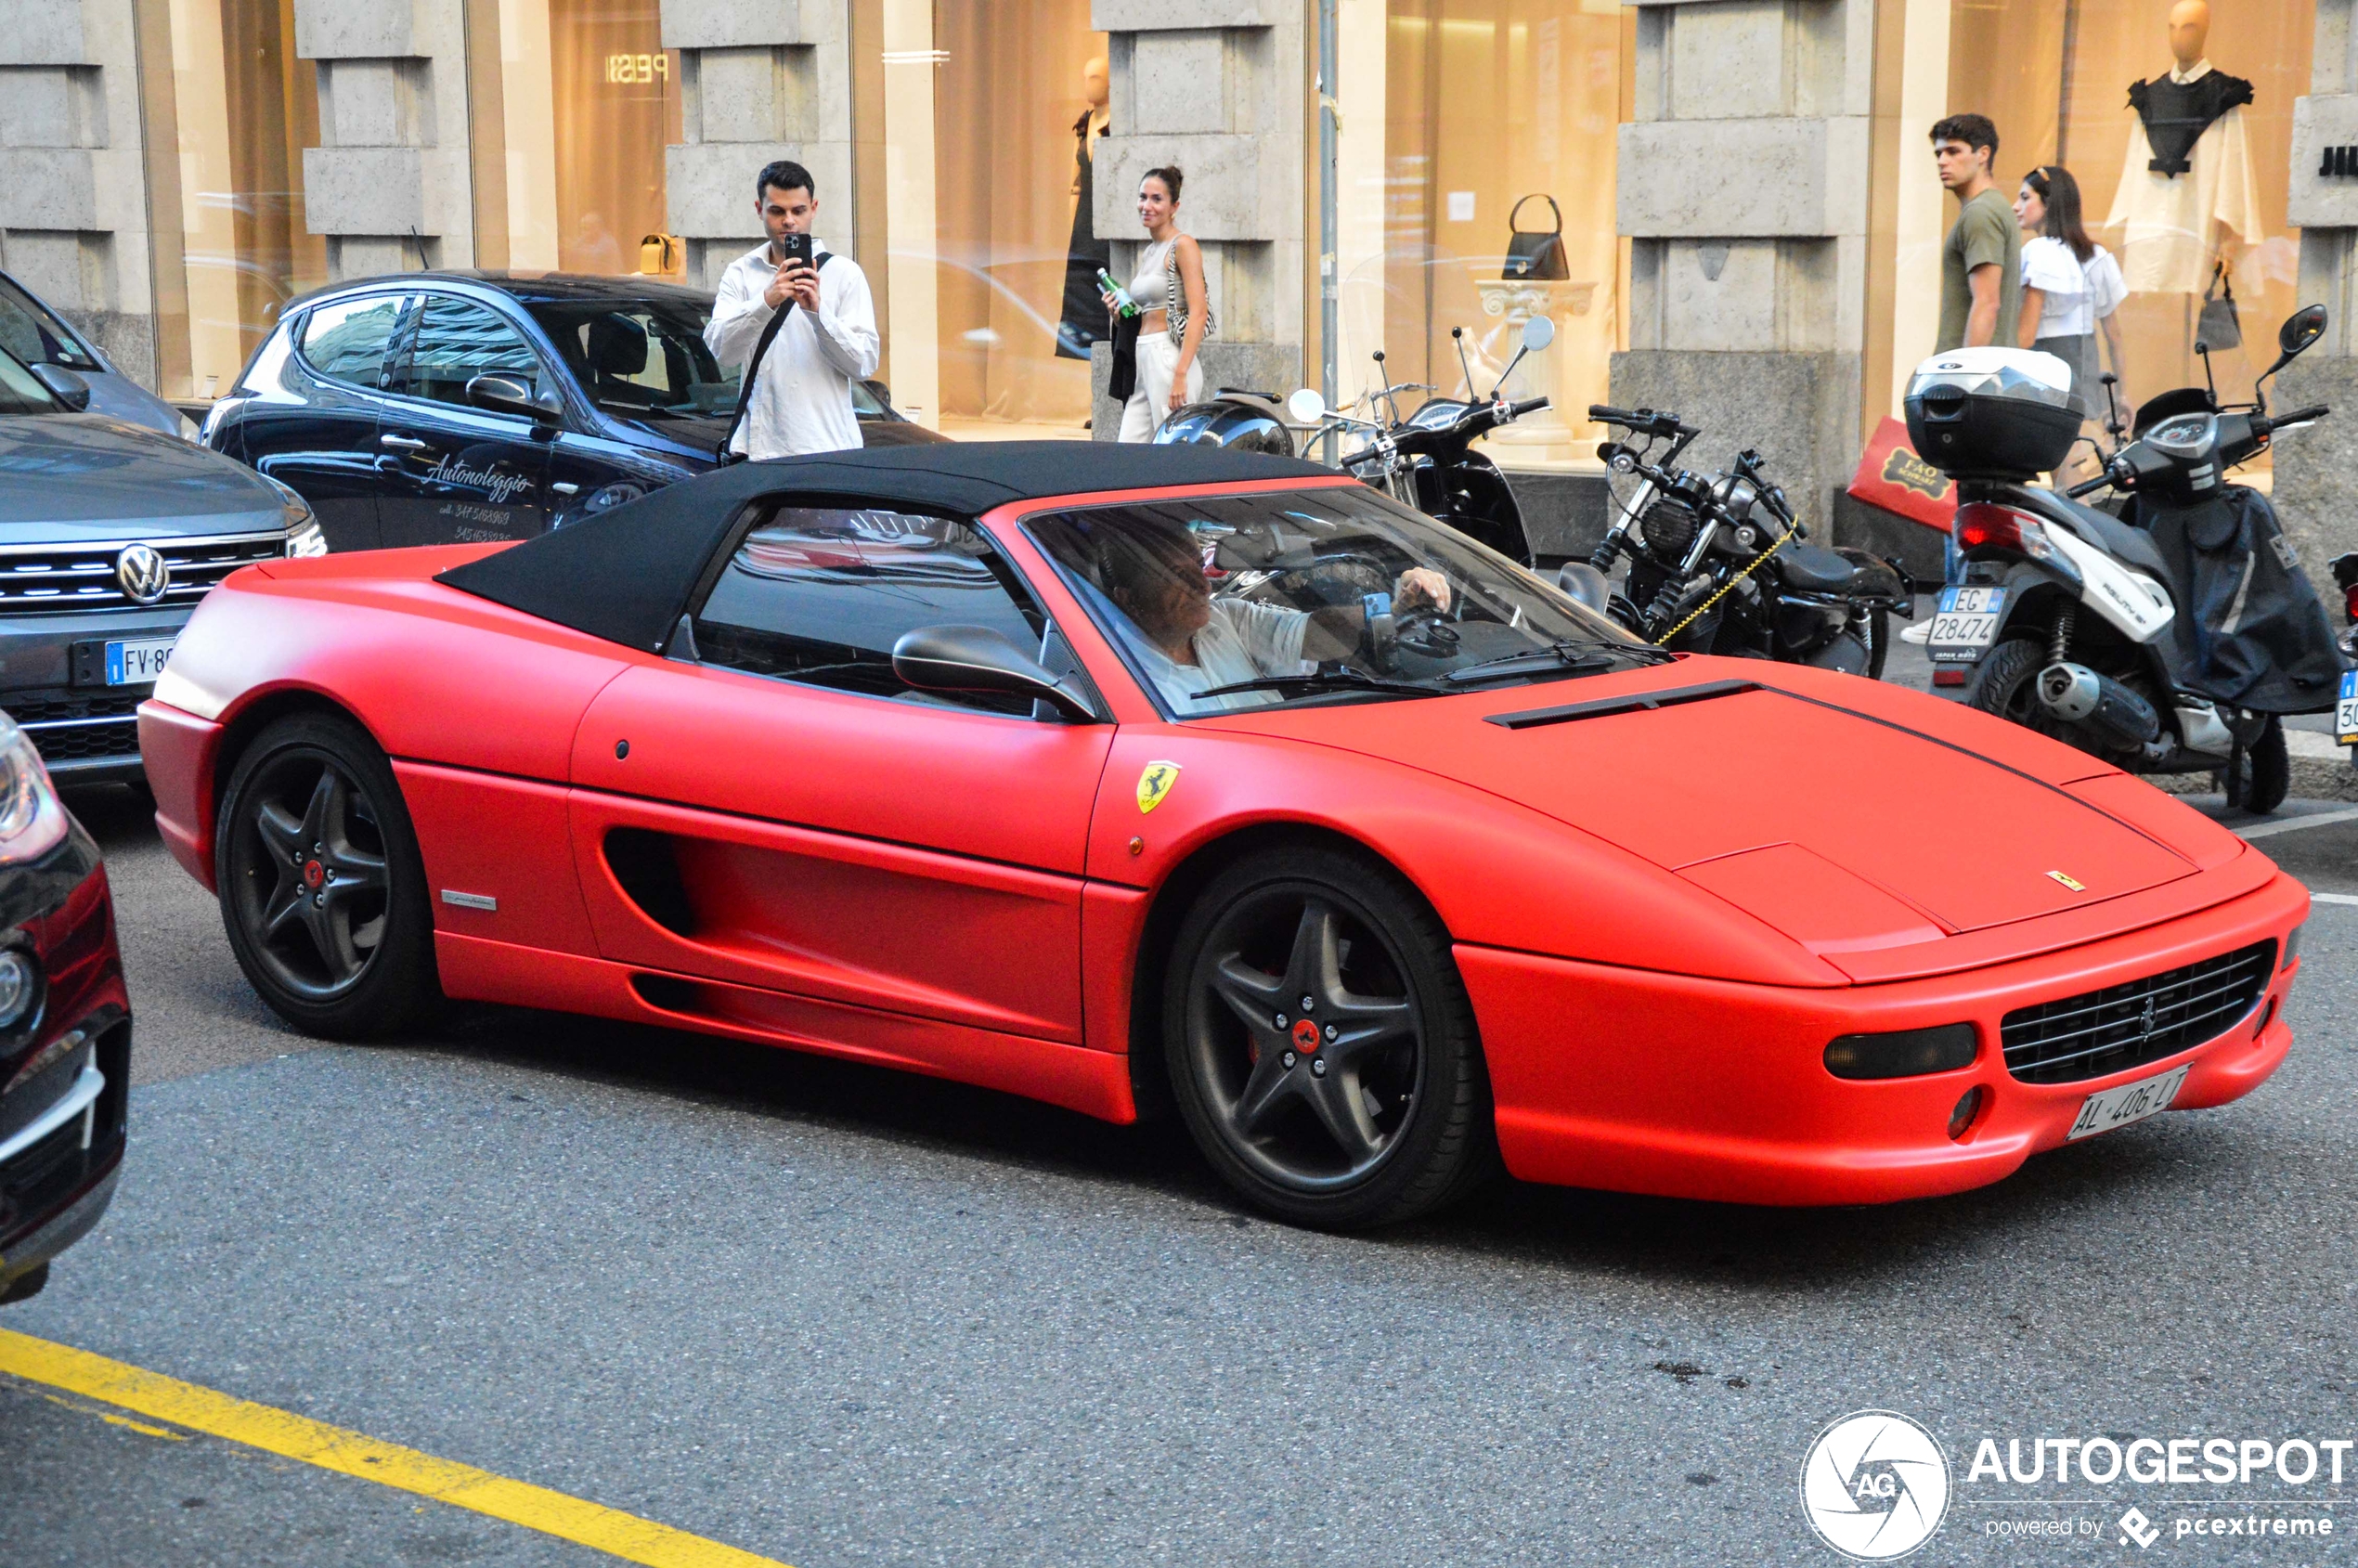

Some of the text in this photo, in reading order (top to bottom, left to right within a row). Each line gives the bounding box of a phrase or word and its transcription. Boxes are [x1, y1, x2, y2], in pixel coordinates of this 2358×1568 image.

[421, 453, 535, 503] Autonoleggio
[1955, 590, 1980, 611] EG
[1934, 618, 1993, 641] 28474
[2073, 1099, 2104, 1133] AL
[2111, 1083, 2156, 1121] 406
